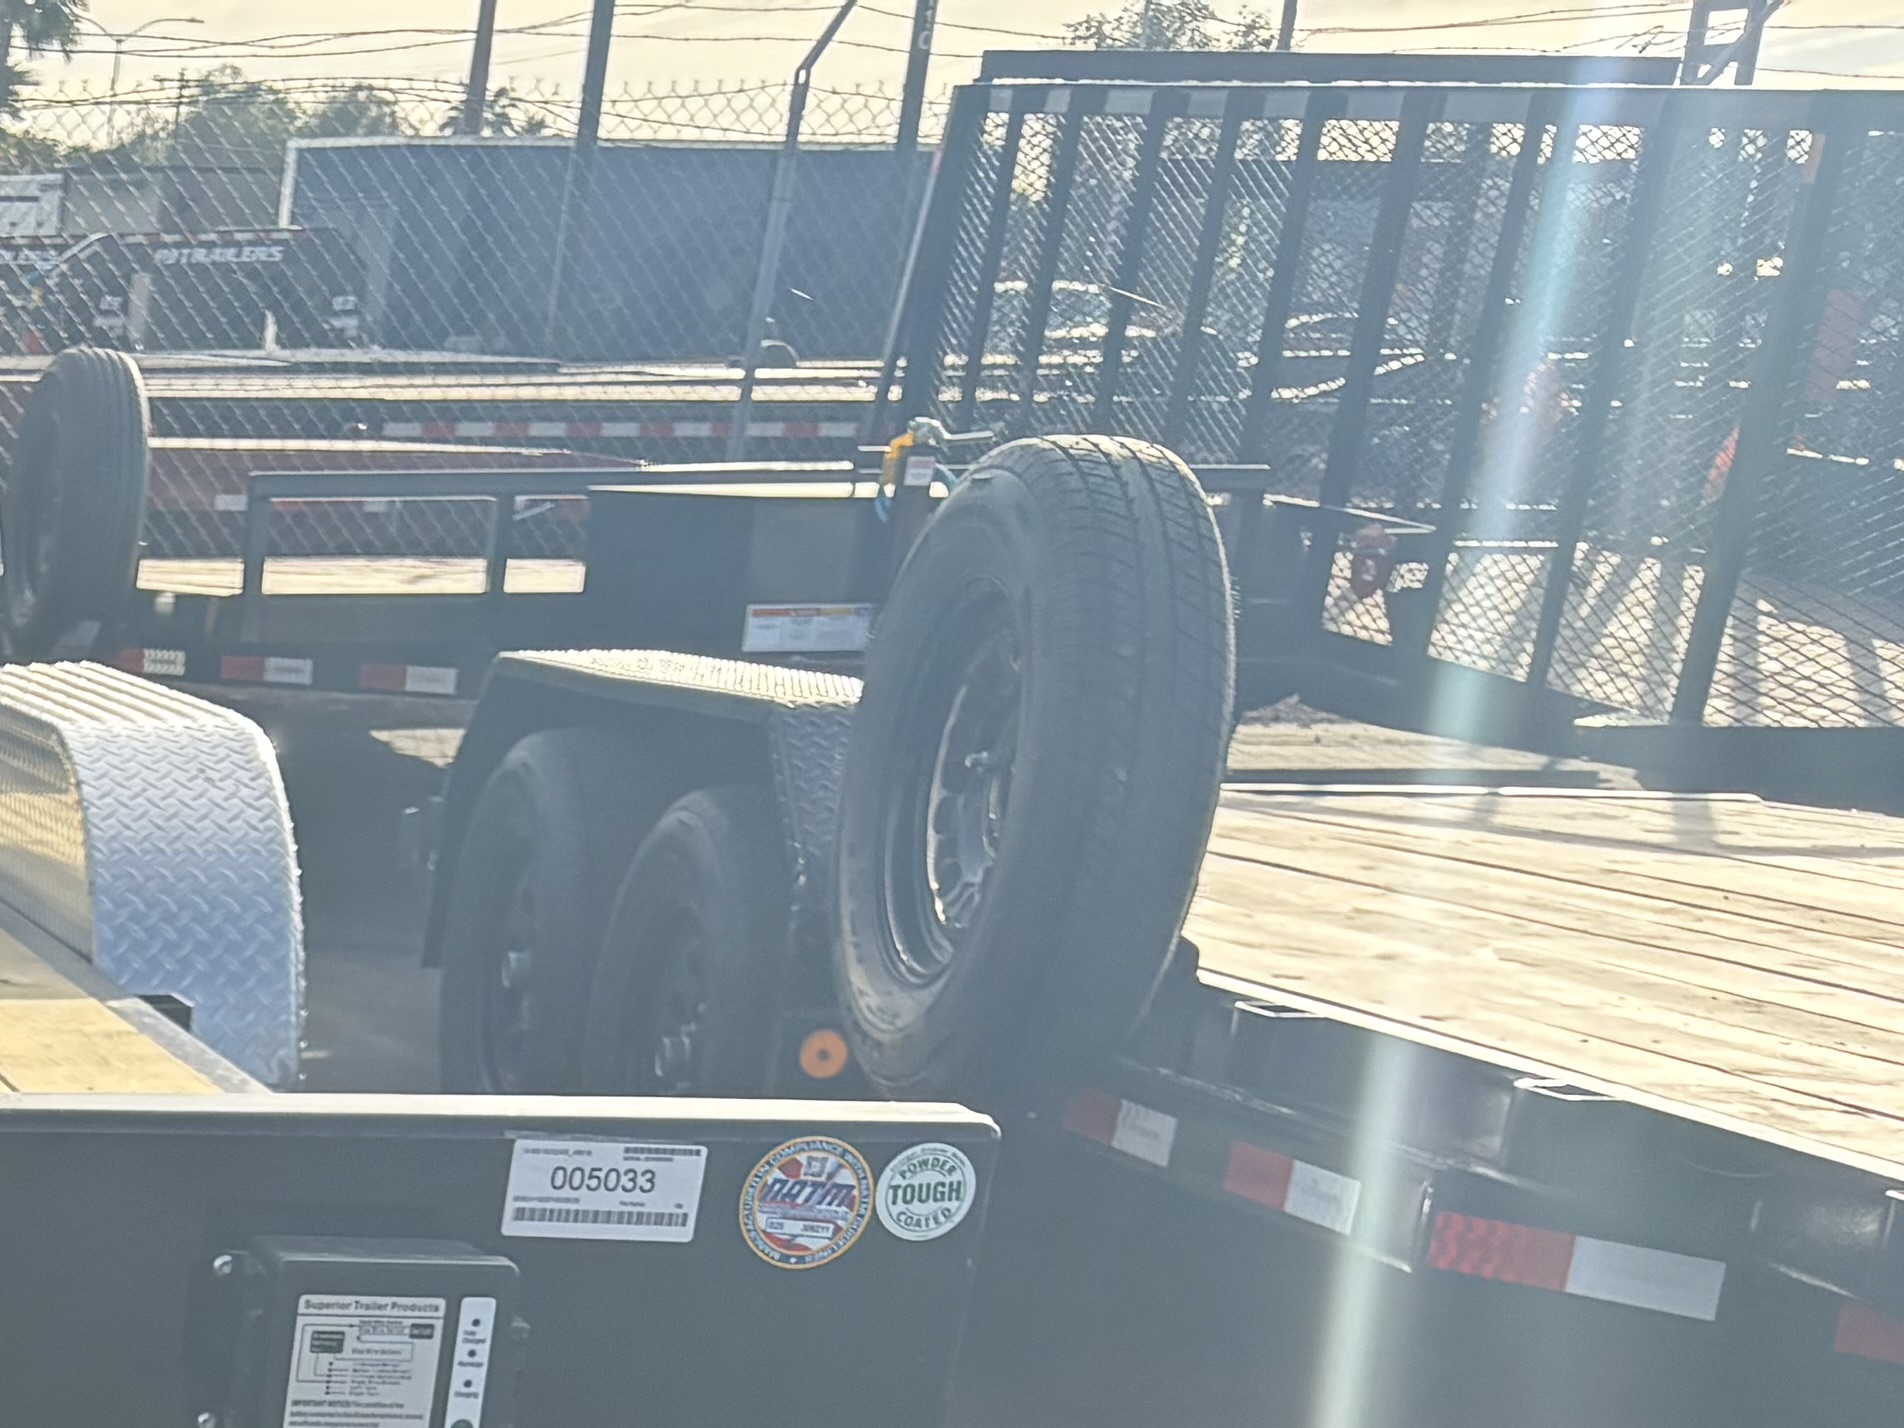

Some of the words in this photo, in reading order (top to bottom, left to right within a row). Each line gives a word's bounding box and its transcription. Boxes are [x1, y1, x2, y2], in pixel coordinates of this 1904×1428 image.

[550, 1166, 656, 1194] 005033
[898, 1157, 957, 1180] POWDER
[889, 1180, 961, 1206] TOUGH
[896, 1207, 952, 1229] COATED
[303, 1299, 352, 1312] Superior
[354, 1300, 390, 1311] Trailer
[391, 1301, 440, 1313] Products
